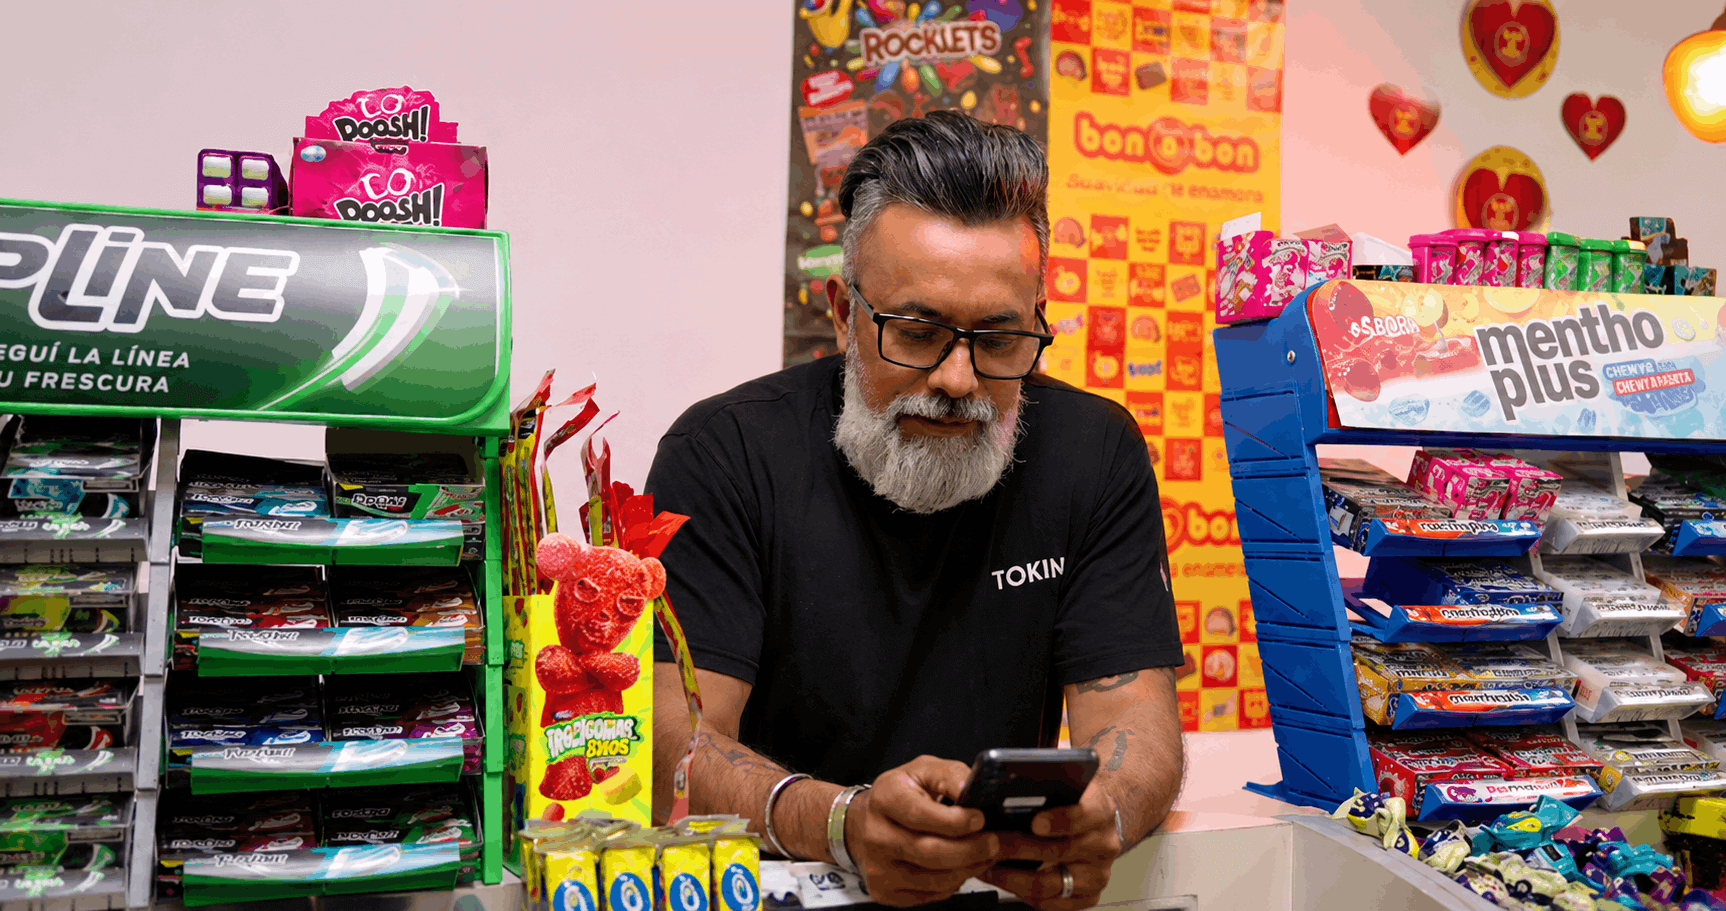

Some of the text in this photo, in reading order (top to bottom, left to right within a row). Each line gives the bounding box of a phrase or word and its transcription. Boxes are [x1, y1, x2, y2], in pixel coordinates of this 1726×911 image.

[863, 25, 997, 62] ROCKLETS
[1475, 303, 1665, 367] mentho
[67, 347, 101, 365] LA
[111, 344, 190, 368] LÍNEA
[24, 371, 169, 393] FRESCURA
[1489, 358, 1600, 422] plus
[991, 556, 1065, 590] TOKIN
